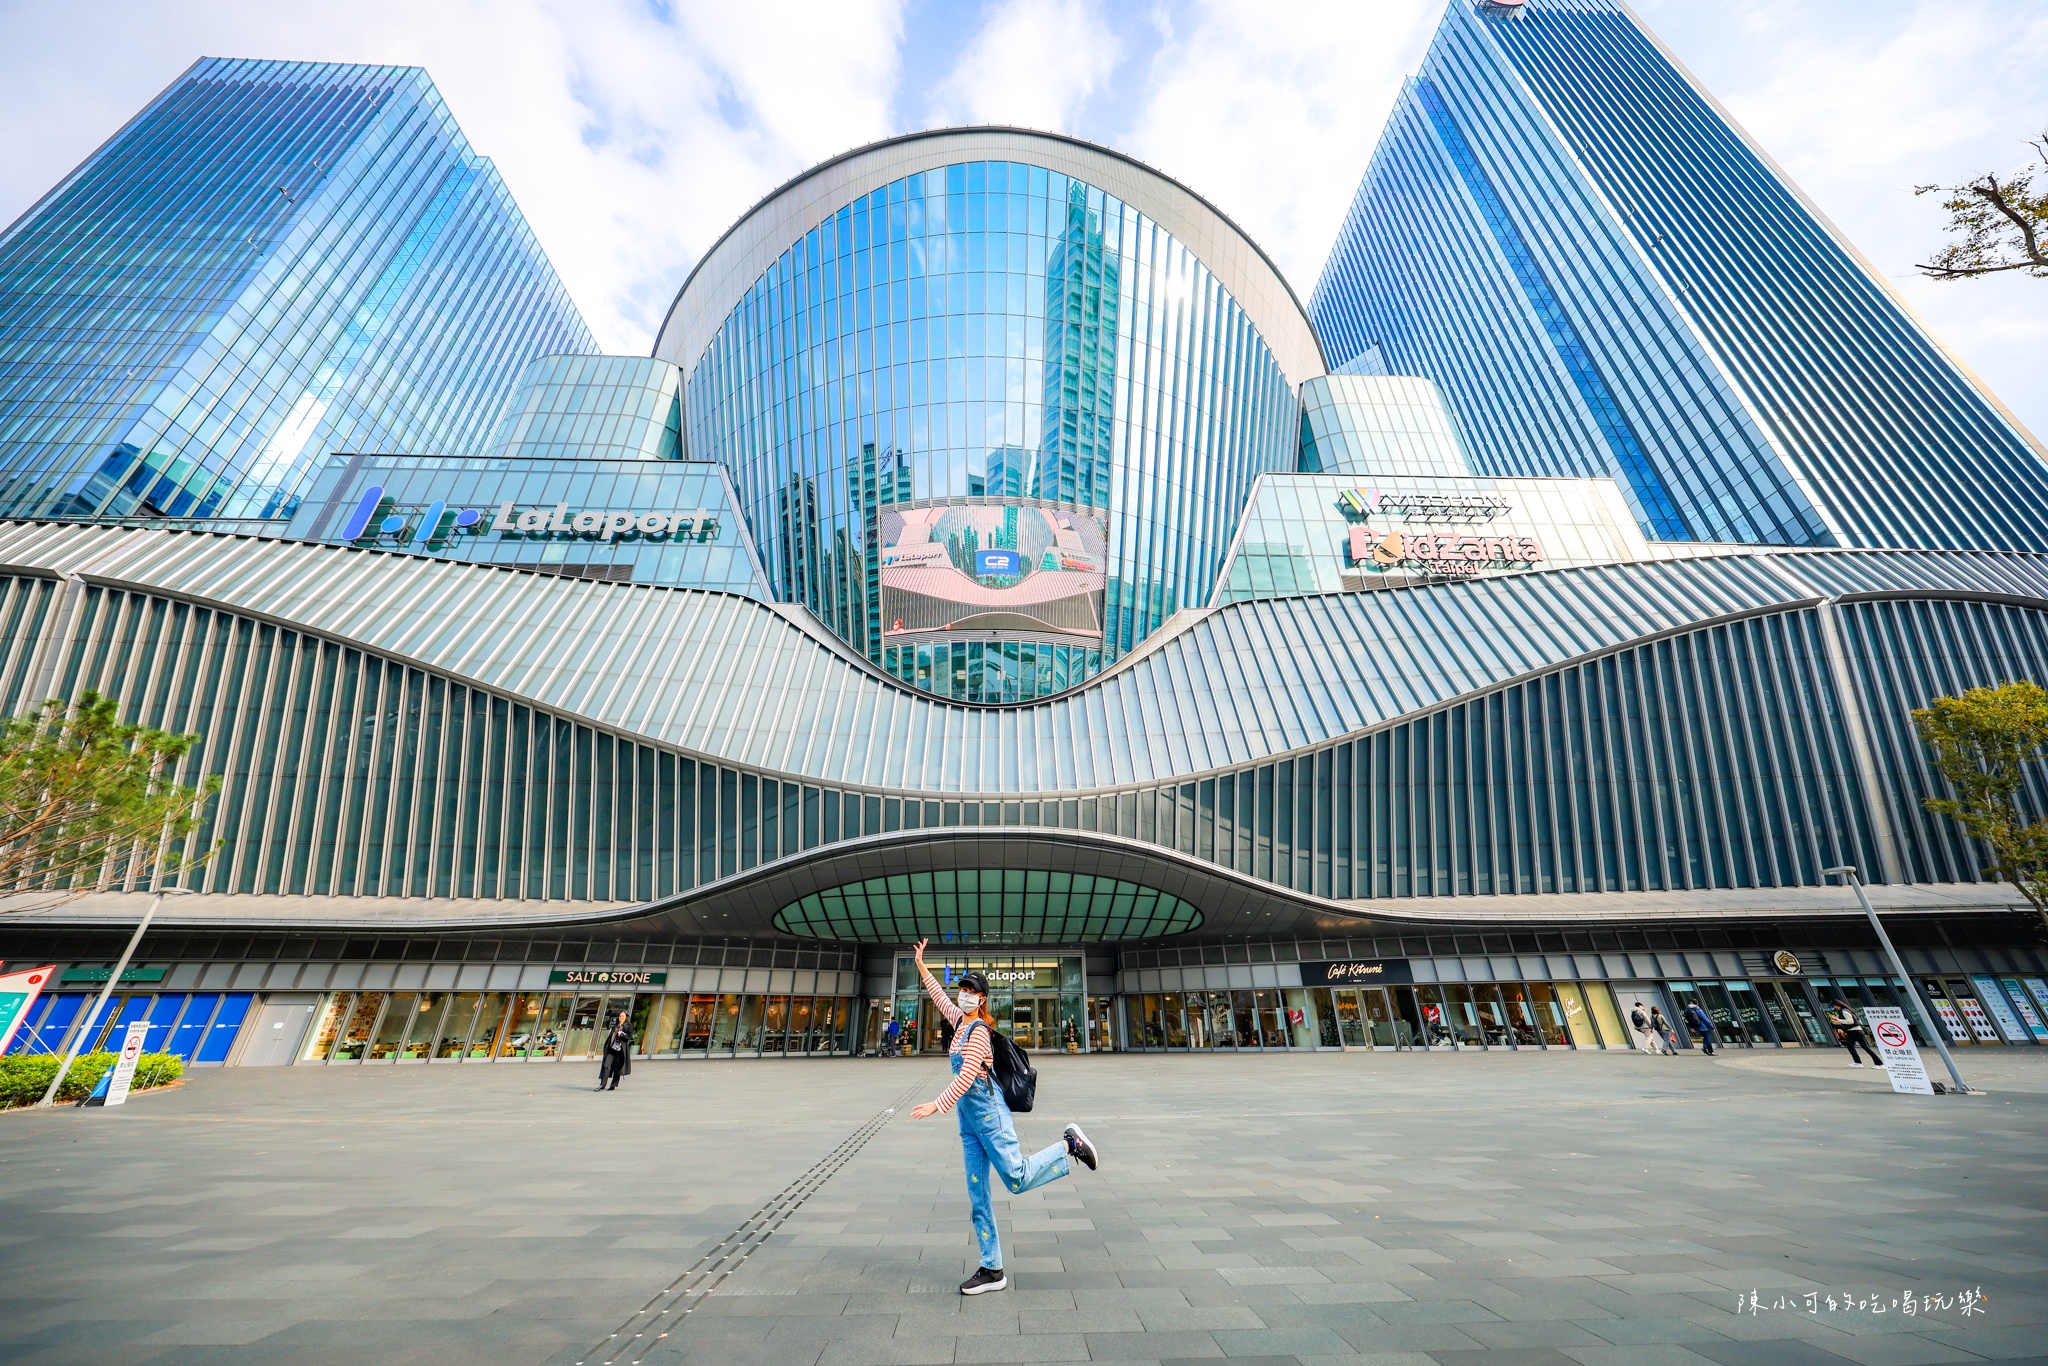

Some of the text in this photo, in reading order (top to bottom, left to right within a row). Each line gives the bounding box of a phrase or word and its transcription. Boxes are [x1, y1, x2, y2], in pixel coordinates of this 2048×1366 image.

[491, 501, 710, 540] LaLaport
[1350, 527, 1544, 563] KidZania
[1431, 561, 1479, 576] Taipei
[566, 971, 651, 984] SALT STONE
[1327, 963, 1347, 980] Café
